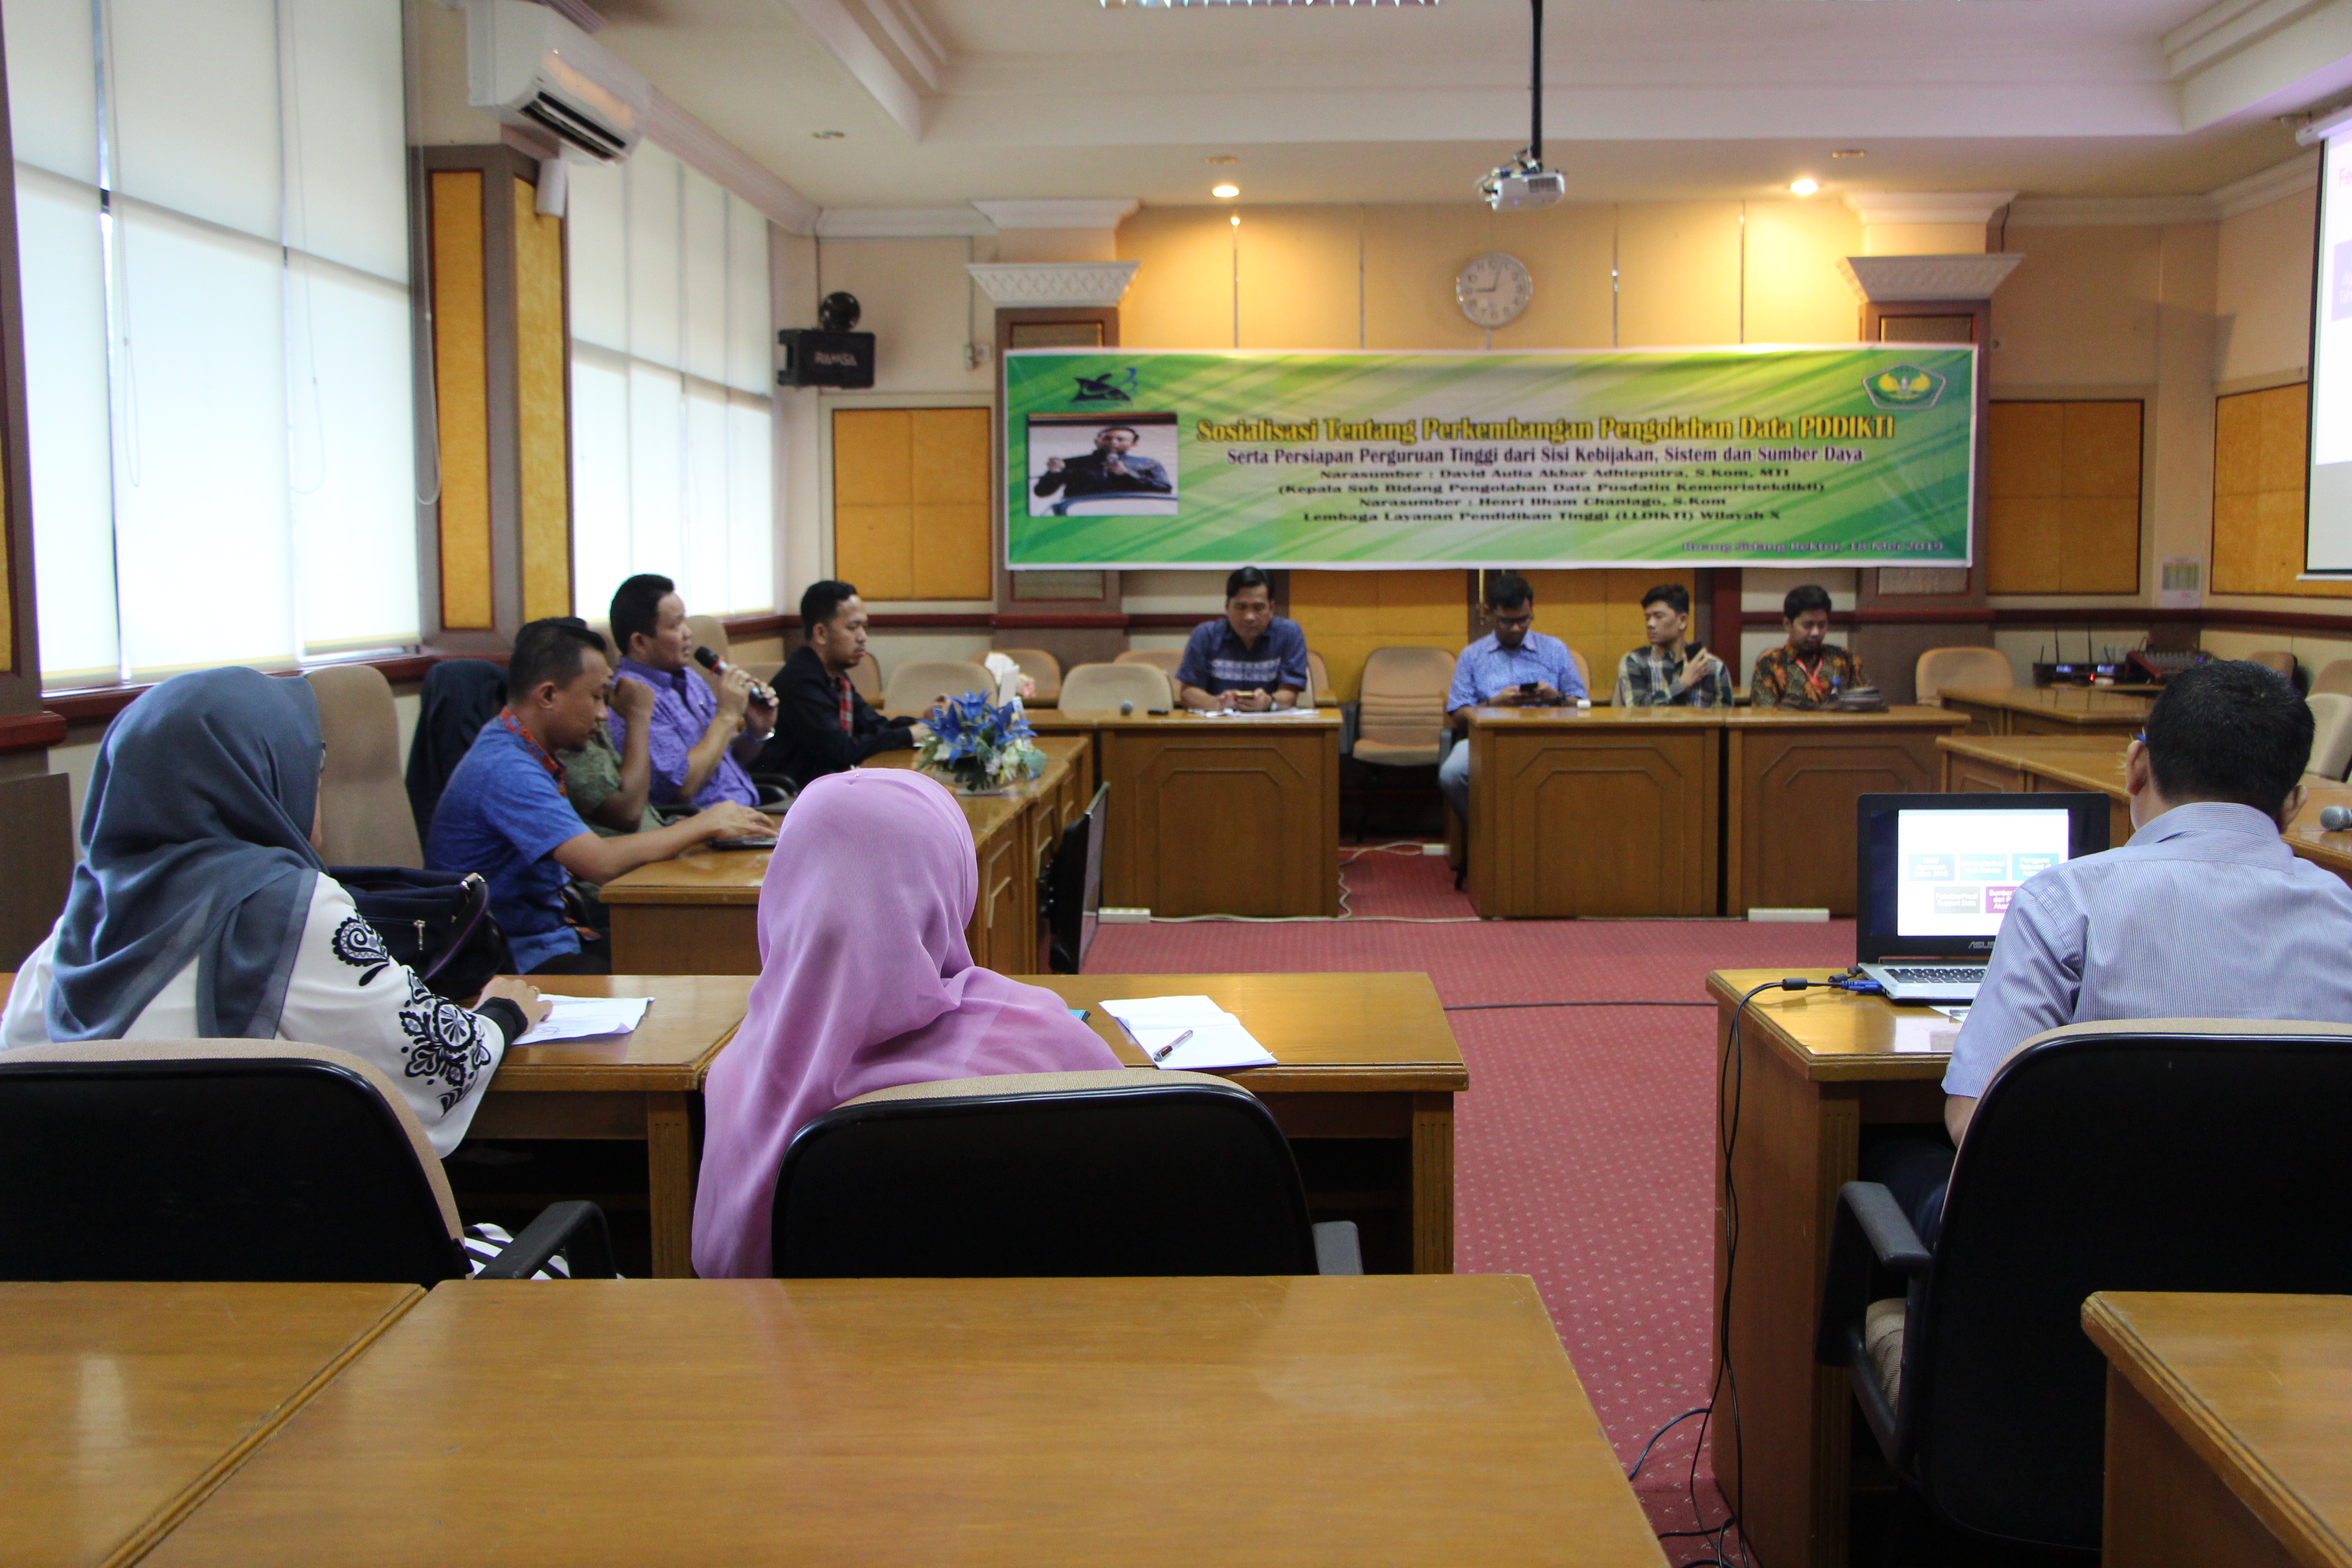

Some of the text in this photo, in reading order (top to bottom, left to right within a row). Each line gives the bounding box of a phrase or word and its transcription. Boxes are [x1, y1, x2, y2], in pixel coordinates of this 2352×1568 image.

[1196, 415, 1894, 446] Sosialisasi Tentang Perkembangan Pengolahan Data PDDIKTI
[1227, 446, 1863, 466] Serta Persiapan Perguruan Tinggi dari Sisi Kebijakan, Sistem dan Sumber Daya
[1320, 470, 1423, 480] Narasumber
[1440, 469, 1485, 478] David
[1491, 469, 1533, 478] Aulia
[1539, 469, 1588, 478] Akbar
[1760, 468, 1789, 477] MTI
[1279, 484, 1342, 495] (Kepala
[1348, 485, 1379, 494] Sub
[1385, 484, 1443, 495] Bidang
[1449, 484, 1547, 494] Pengolahan
[1553, 483, 1591, 493] Data
[1359, 498, 1462, 507] Narasumber
[1479, 498, 1524, 507] Henri
[1531, 498, 1577, 507] Ilham
[1673, 497, 1726, 505] S.Kom
[1303, 513, 1378, 523] Lembaga
[1384, 512, 1453, 522] Layanan
[1459, 512, 1552, 521] Pendidikan
[1560, 511, 1609, 522] Tinggi
[1700, 511, 1764, 520] Wilayah
[1968, 941, 1995, 949] ASUS
